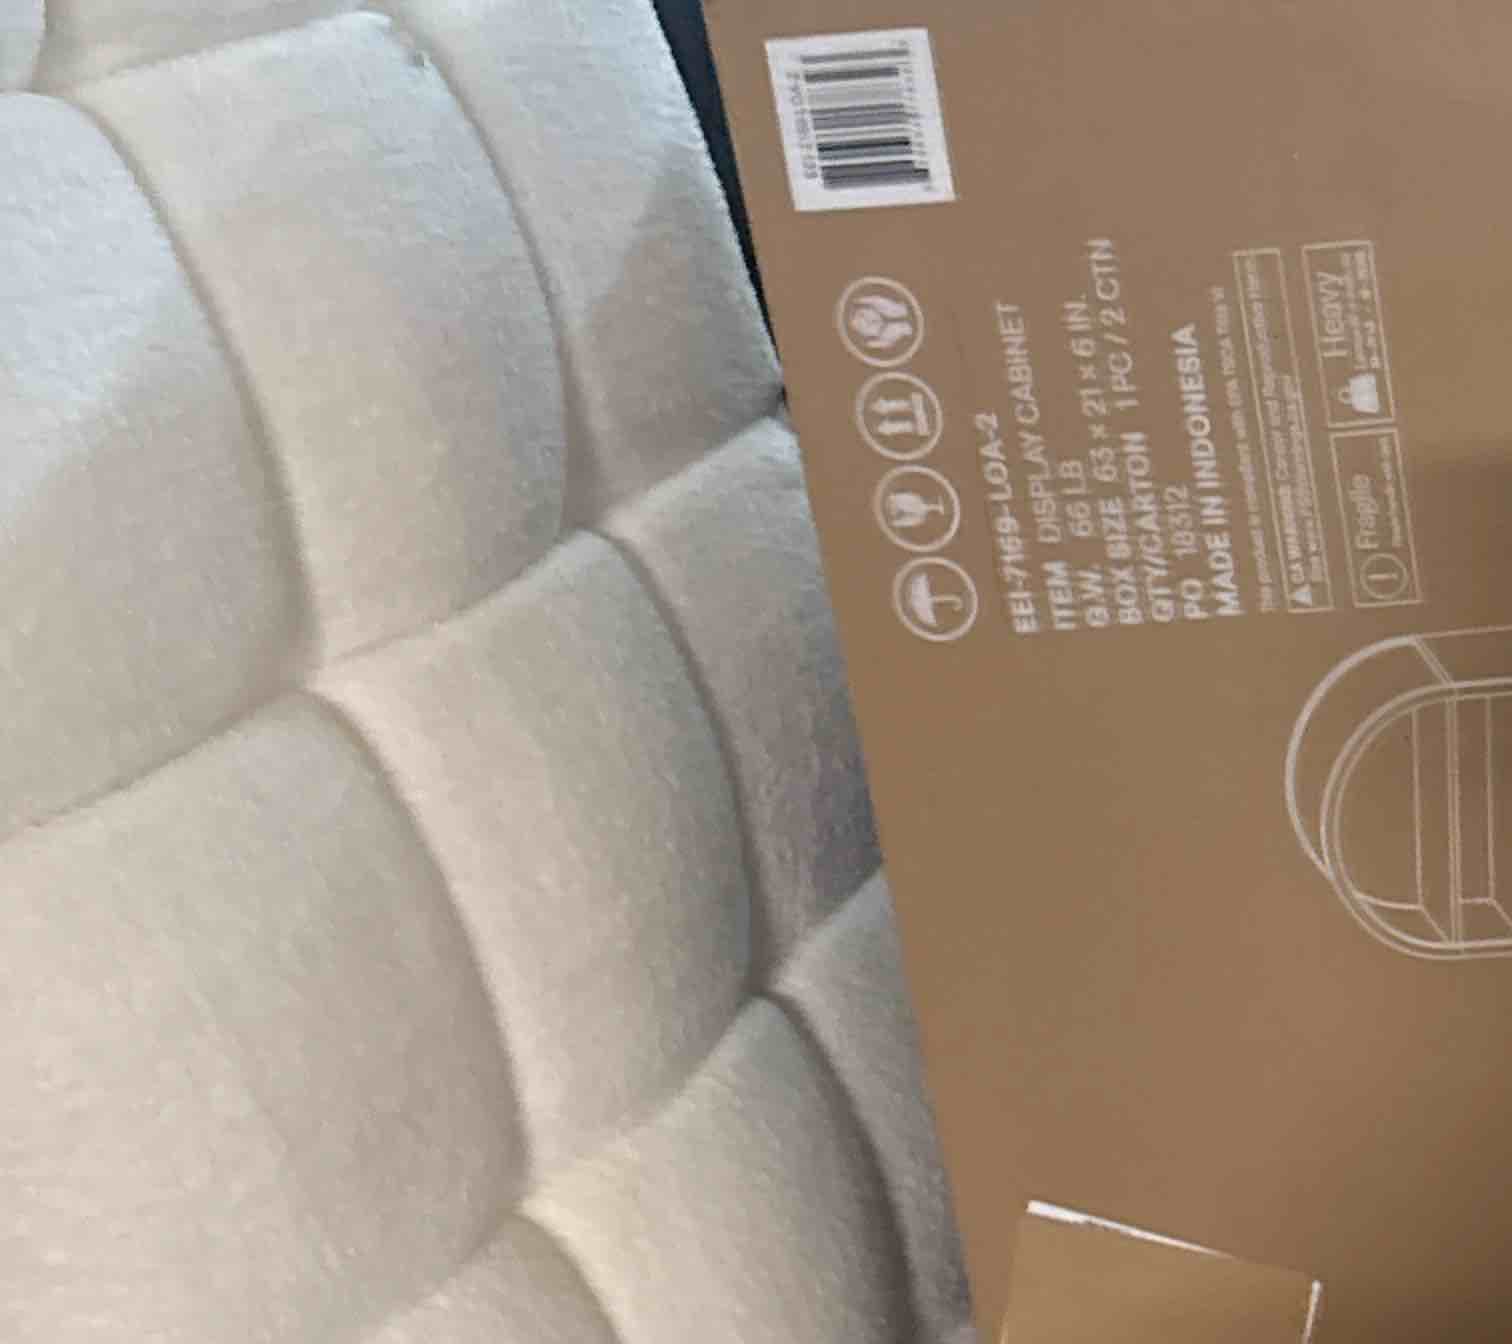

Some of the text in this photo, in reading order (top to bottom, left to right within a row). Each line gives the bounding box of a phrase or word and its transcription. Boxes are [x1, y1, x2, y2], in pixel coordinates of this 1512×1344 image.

[1087, 237, 1122, 300] CTN
[1099, 306, 1127, 325] 2
[1307, 269, 1356, 358] Heavy
[1107, 351, 1138, 391] PC
[994, 300, 1078, 629] ITEM DISPLAY CABINET
[1059, 459, 1087, 494] LB
[1167, 323, 1245, 616] MADE IN INDONESIA
[974, 412, 1038, 632] EEI-7169-LOA-2
[1098, 496, 1131, 558] SIZE
[1121, 431, 1179, 622] QTY/CARTON
[1344, 471, 1386, 549] Fragile
[1110, 564, 1143, 624] BOX
[1179, 578, 1209, 618] PO
